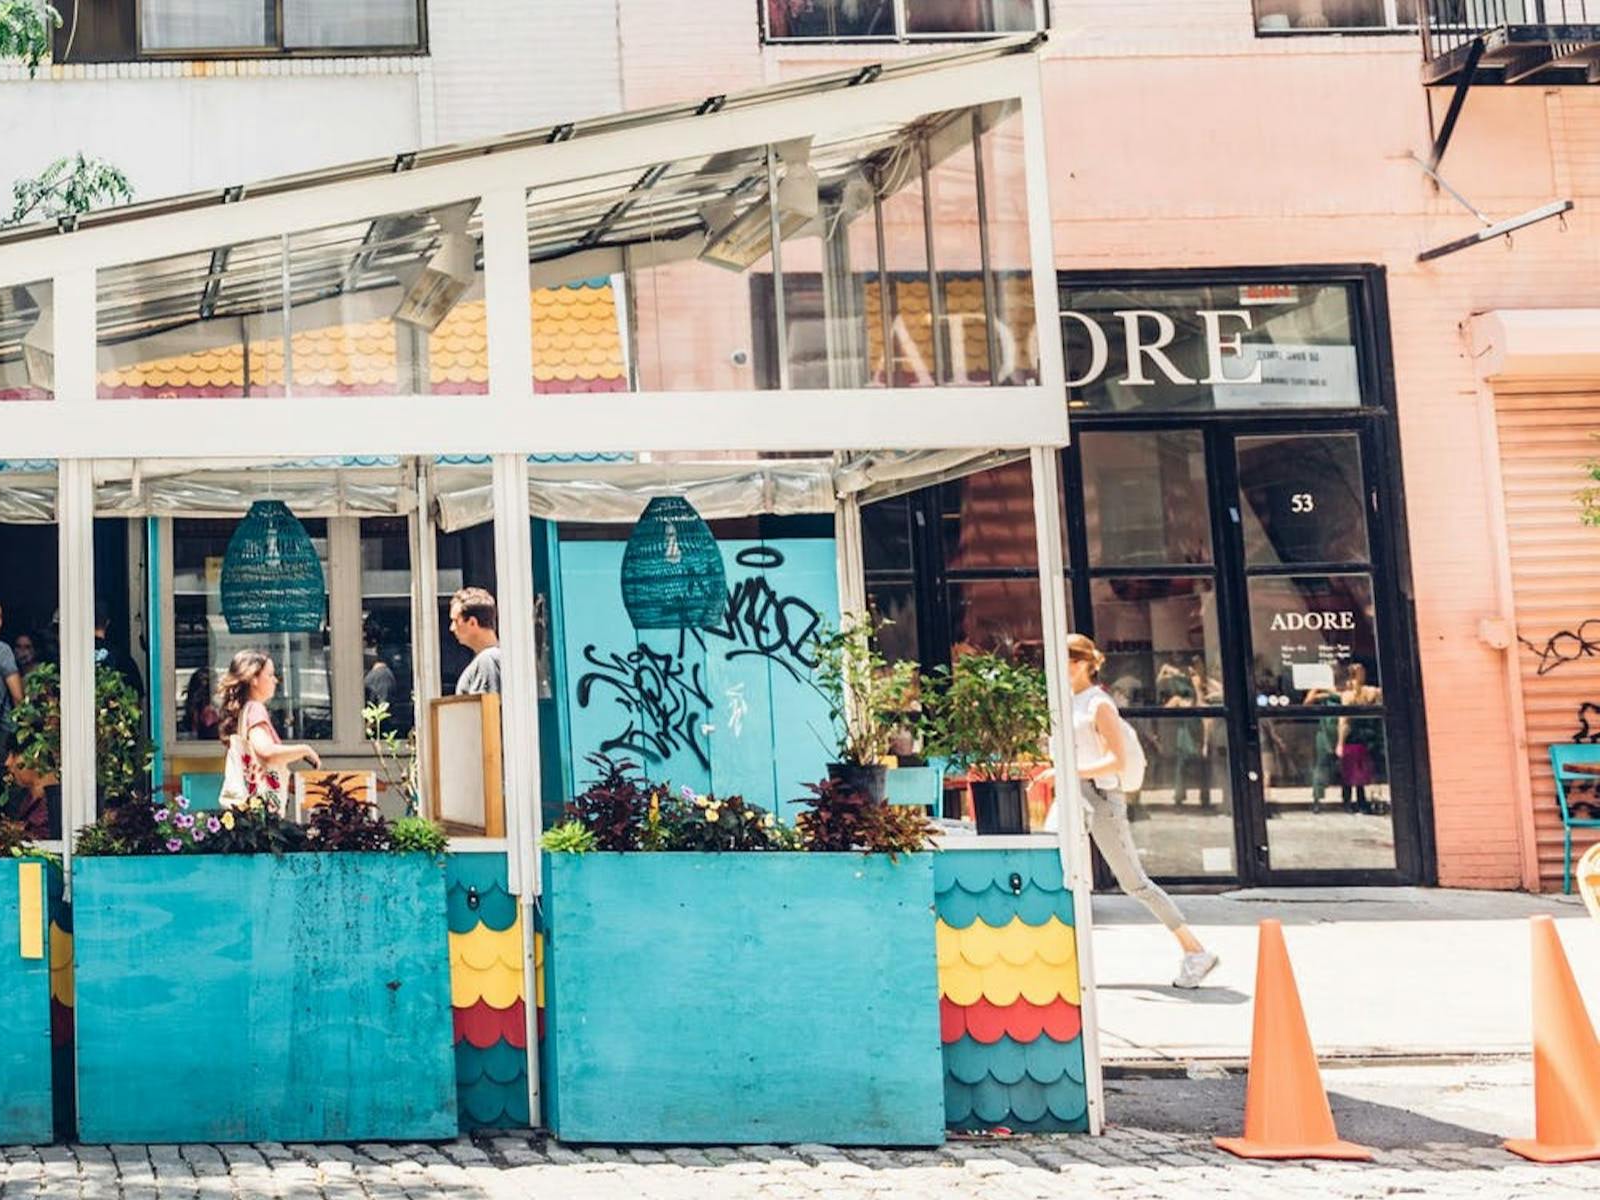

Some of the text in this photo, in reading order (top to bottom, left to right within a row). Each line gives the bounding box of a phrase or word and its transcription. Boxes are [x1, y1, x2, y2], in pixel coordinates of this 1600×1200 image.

[864, 311, 1261, 386] ADORE
[1291, 494, 1314, 512] 53
[1270, 611, 1355, 630] ADORE
